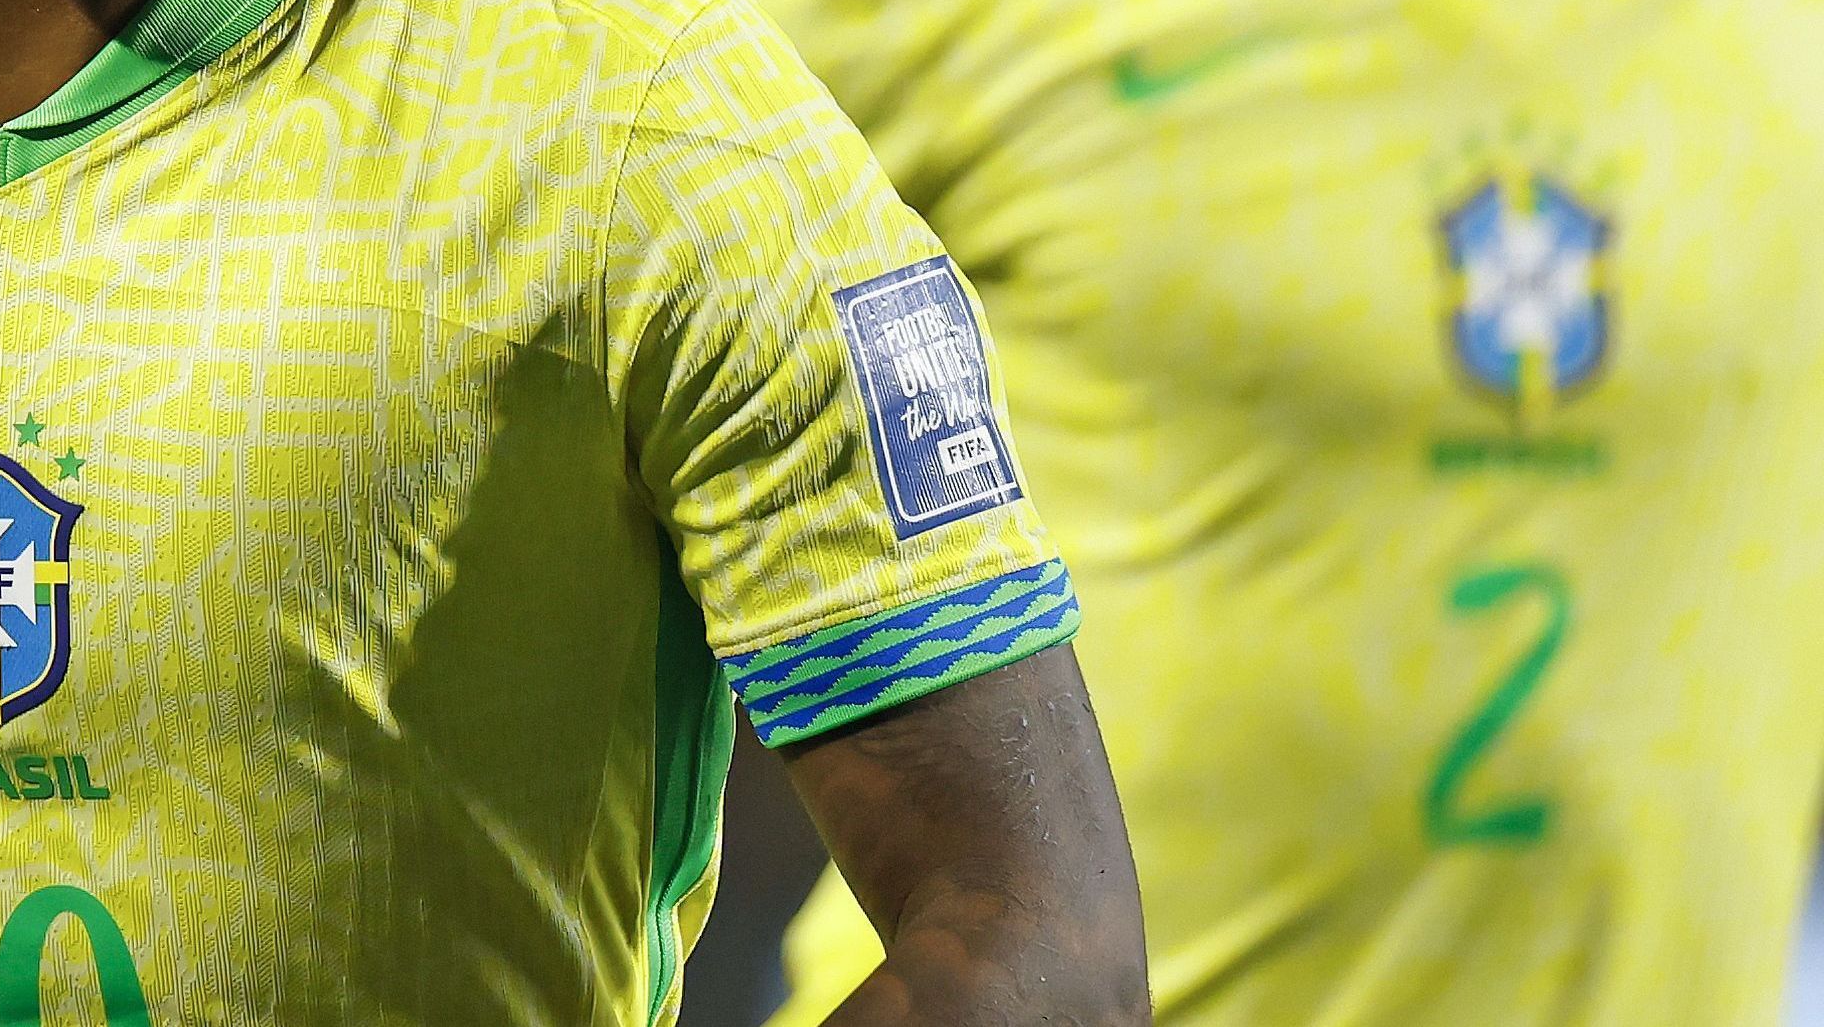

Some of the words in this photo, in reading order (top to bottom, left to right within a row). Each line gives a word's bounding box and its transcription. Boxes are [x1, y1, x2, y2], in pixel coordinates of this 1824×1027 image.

[900, 397, 943, 442] the
[947, 437, 990, 465] FIFA
[1426, 566, 1572, 845] 2
